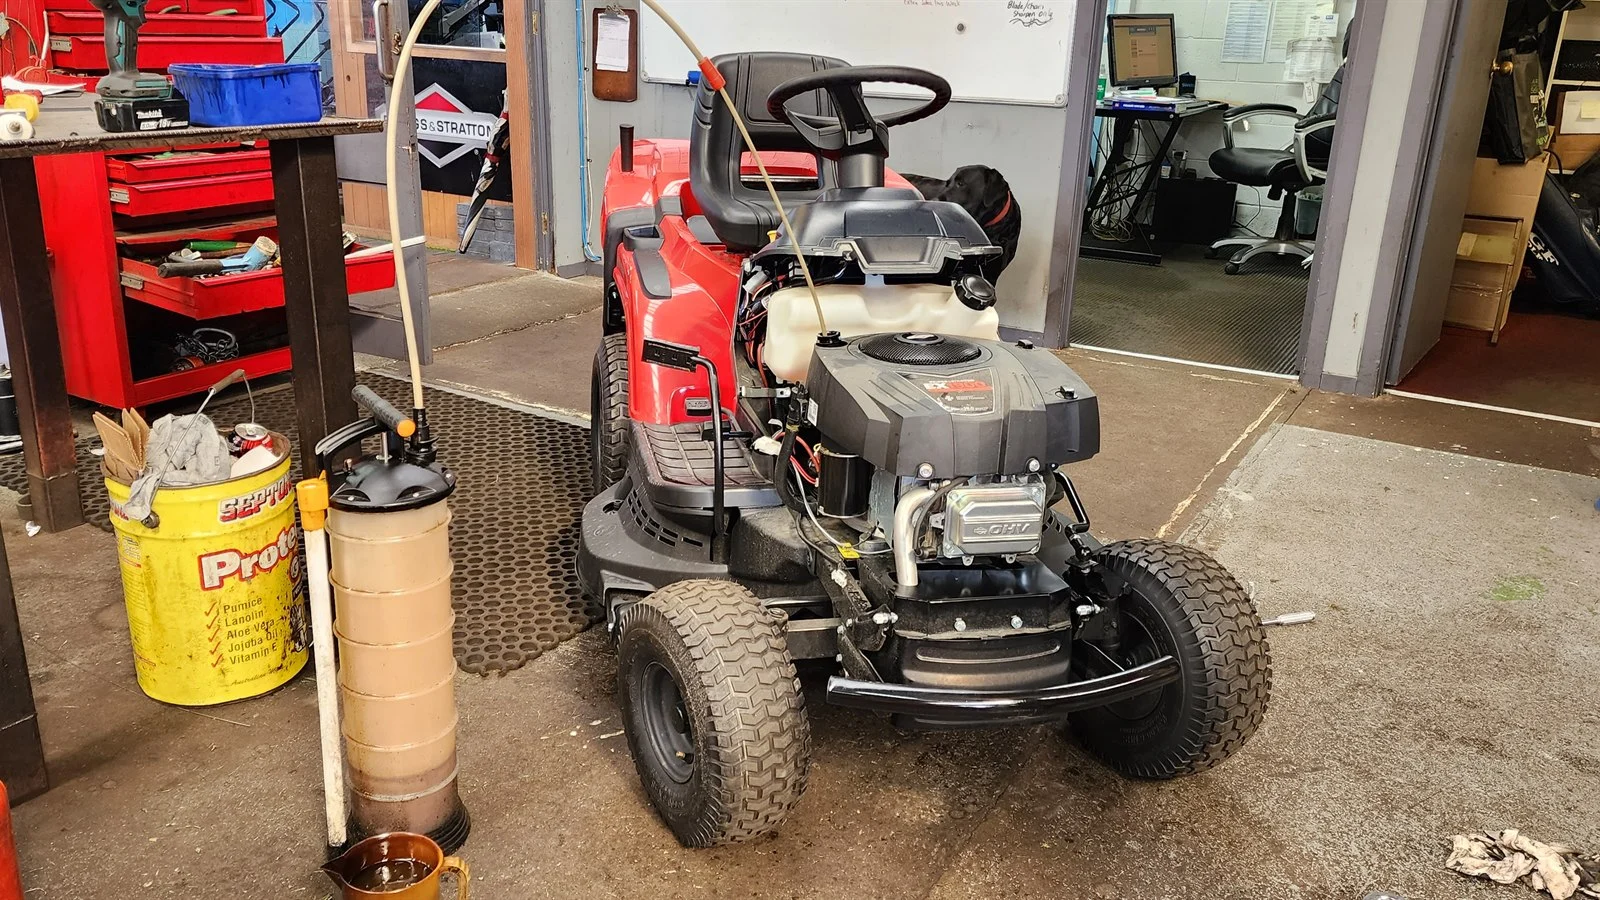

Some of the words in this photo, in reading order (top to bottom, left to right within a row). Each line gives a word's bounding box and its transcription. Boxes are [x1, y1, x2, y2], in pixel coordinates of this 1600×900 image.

[223, 597, 263, 614] Pumice
[225, 610, 264, 627] Lanolin
[227, 628, 251, 640] Aloe
[254, 619, 275, 632] Vera
[228, 638, 263, 653] Jojoba
[266, 629, 278, 641] Oil
[229, 647, 270, 665] Vitamin
[272, 642, 278, 652] E
